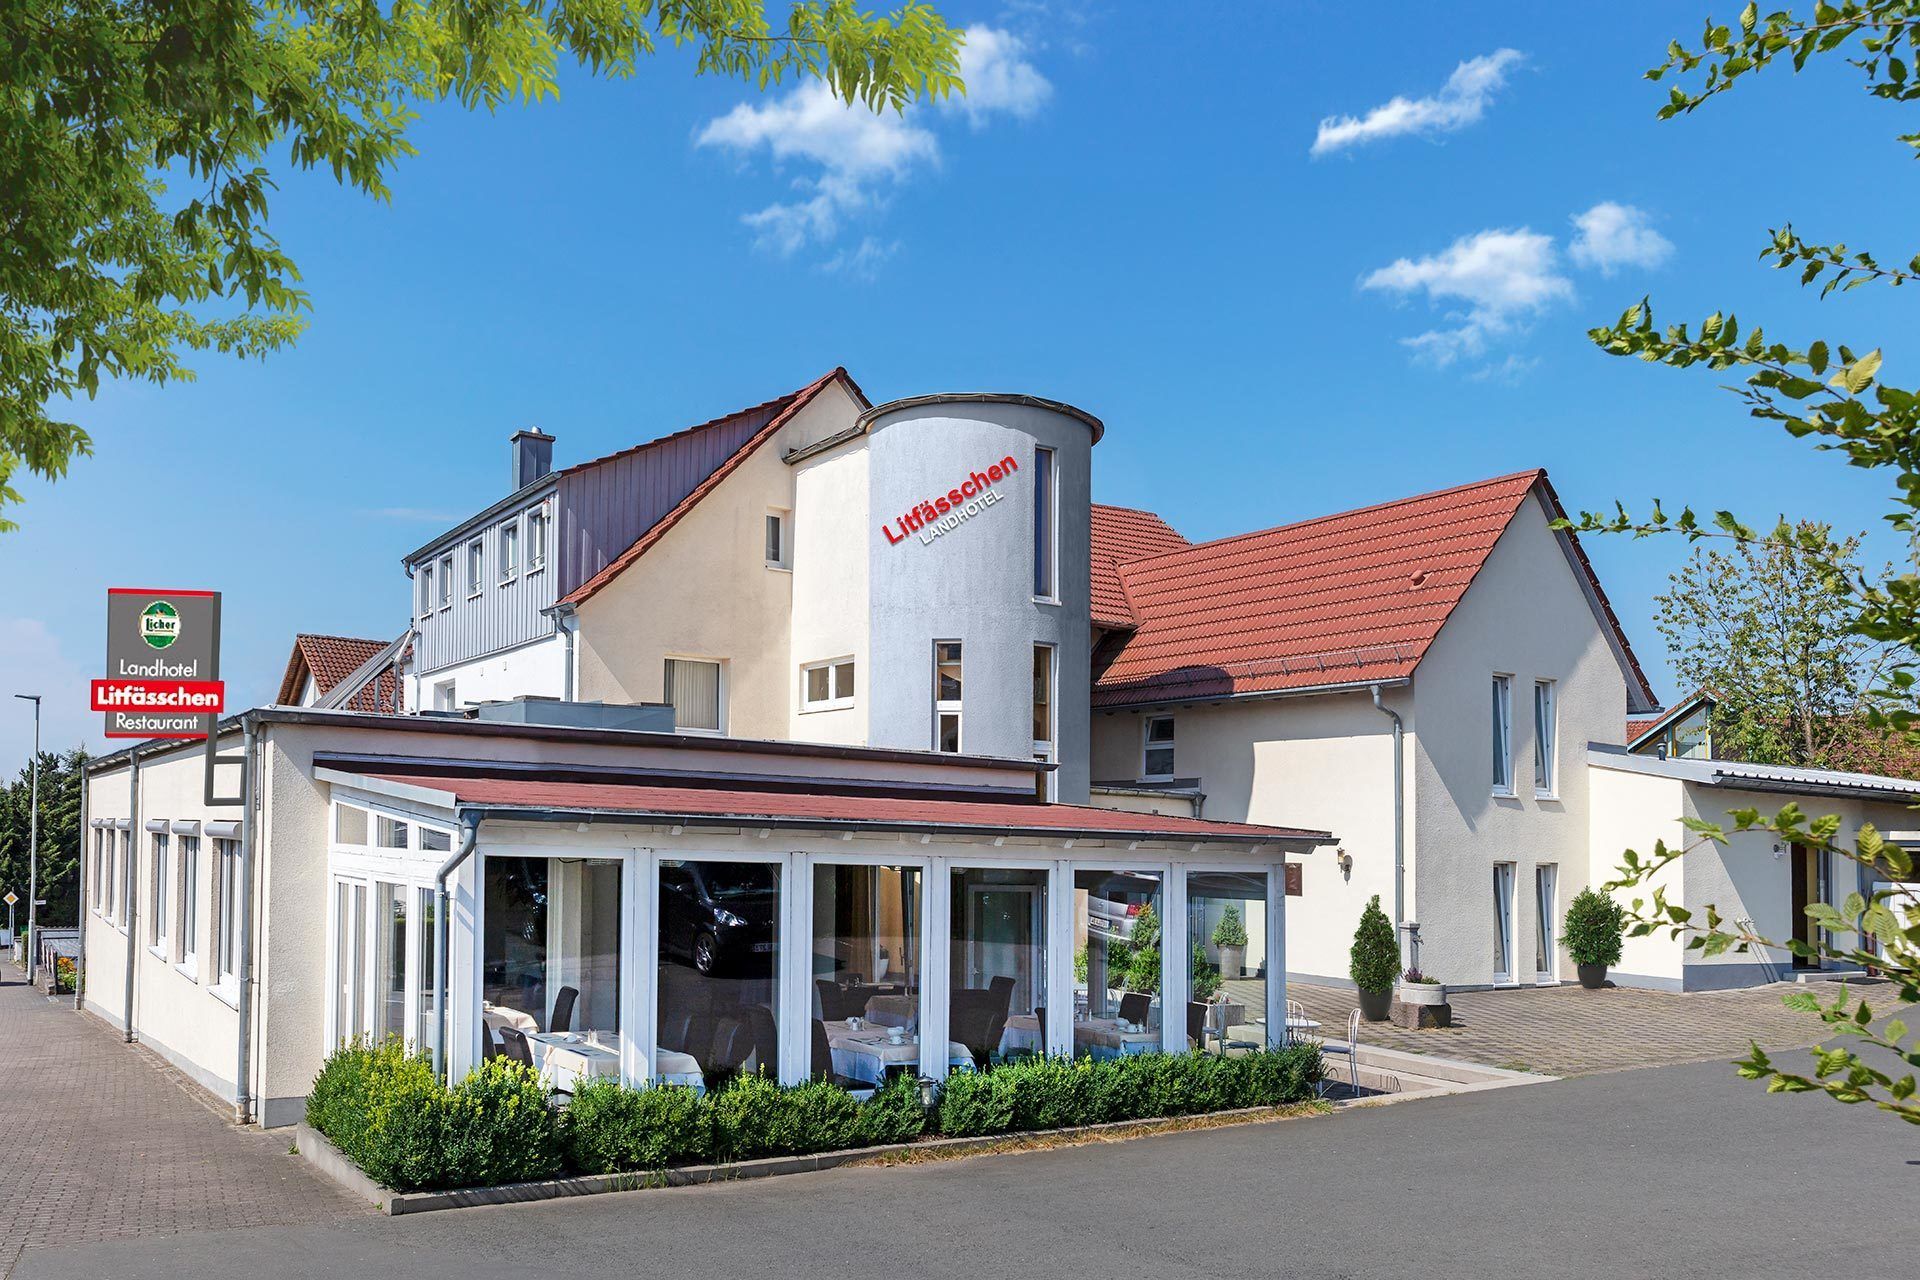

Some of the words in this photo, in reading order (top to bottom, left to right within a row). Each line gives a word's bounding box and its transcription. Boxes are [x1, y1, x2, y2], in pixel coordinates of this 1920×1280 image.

[882, 455, 1018, 545] Litfässchen
[919, 489, 1004, 545] LANDHOTEL
[146, 617, 175, 631] Licher
[119, 658, 197, 677] Landhotel
[97, 685, 219, 707] Litfässchen
[116, 712, 198, 730] Restaurant
